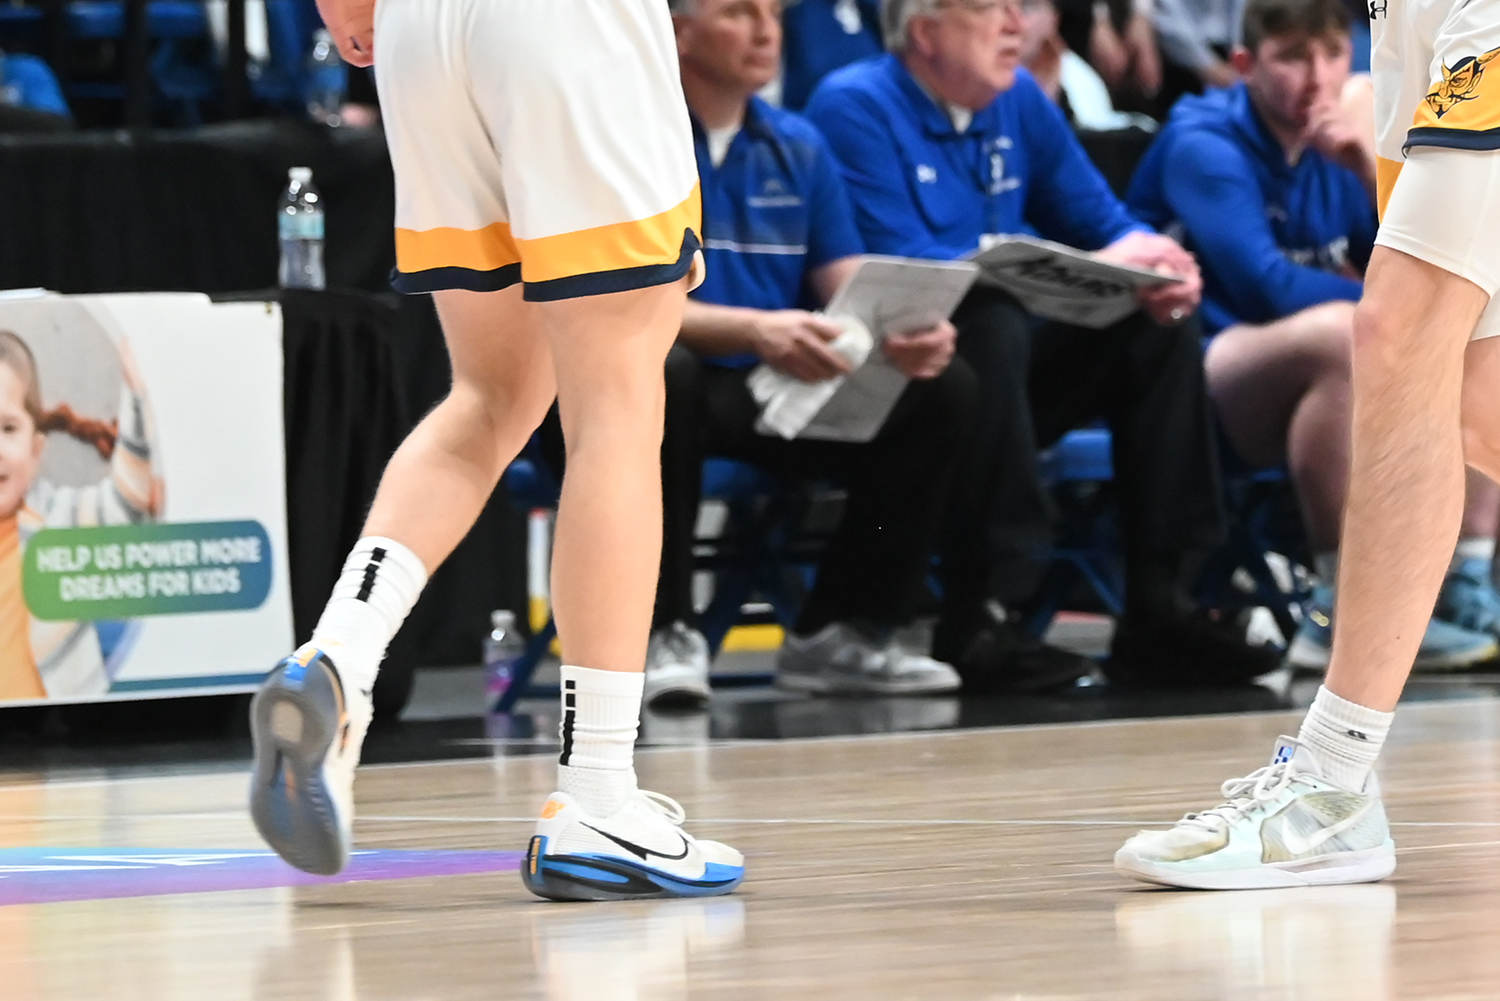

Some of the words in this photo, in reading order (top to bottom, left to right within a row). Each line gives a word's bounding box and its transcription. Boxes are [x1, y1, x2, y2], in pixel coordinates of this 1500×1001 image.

[36, 545, 92, 573] HELP
[93, 543, 123, 570] US
[125, 540, 199, 568] POWER
[200, 536, 262, 565] MORE
[59, 572, 146, 601] DREAMS
[148, 570, 190, 596] FOR
[192, 567, 241, 594] KIDS
